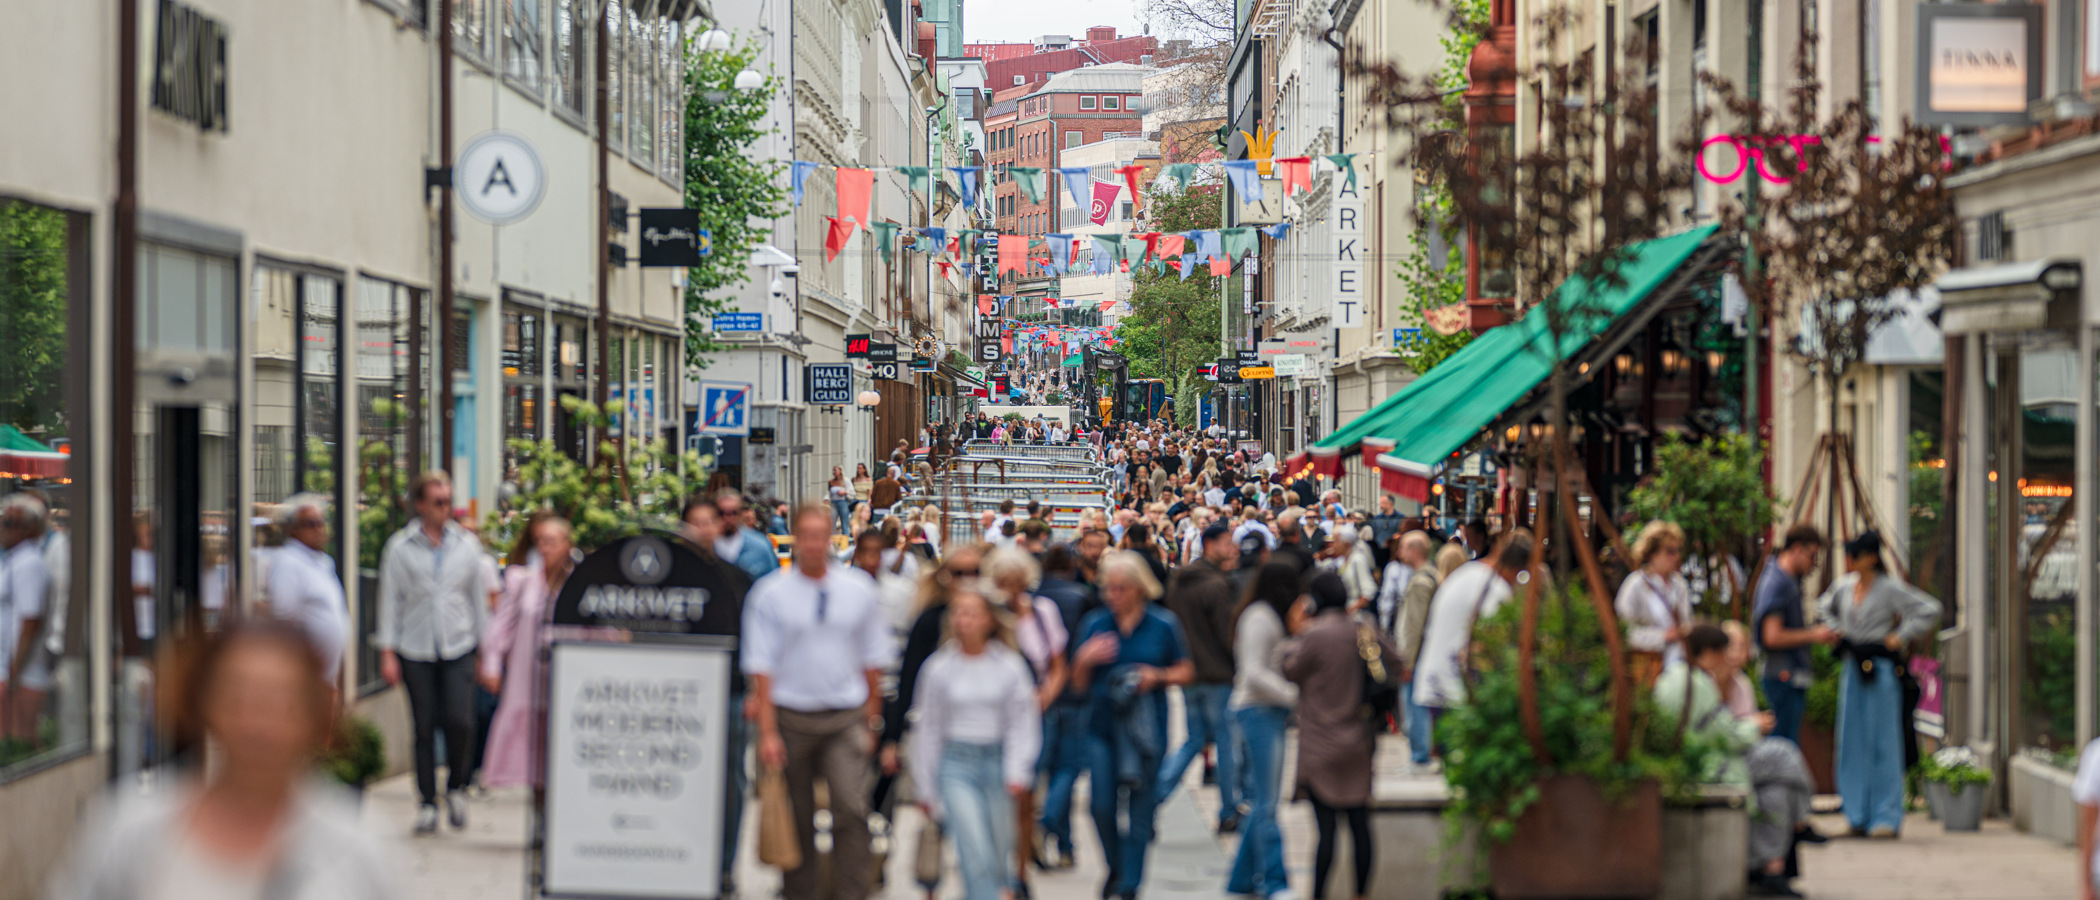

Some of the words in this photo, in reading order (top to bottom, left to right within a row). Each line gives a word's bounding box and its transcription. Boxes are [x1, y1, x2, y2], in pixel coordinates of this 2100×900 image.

[481, 157, 517, 196] A
[1339, 179, 1358, 324] ARKET
[815, 368, 847, 378] HALL
[871, 364, 896, 379] MQ
[1223, 365, 1240, 373] ec
[815, 379, 848, 389] BERG
[815, 390, 848, 401] GULD
